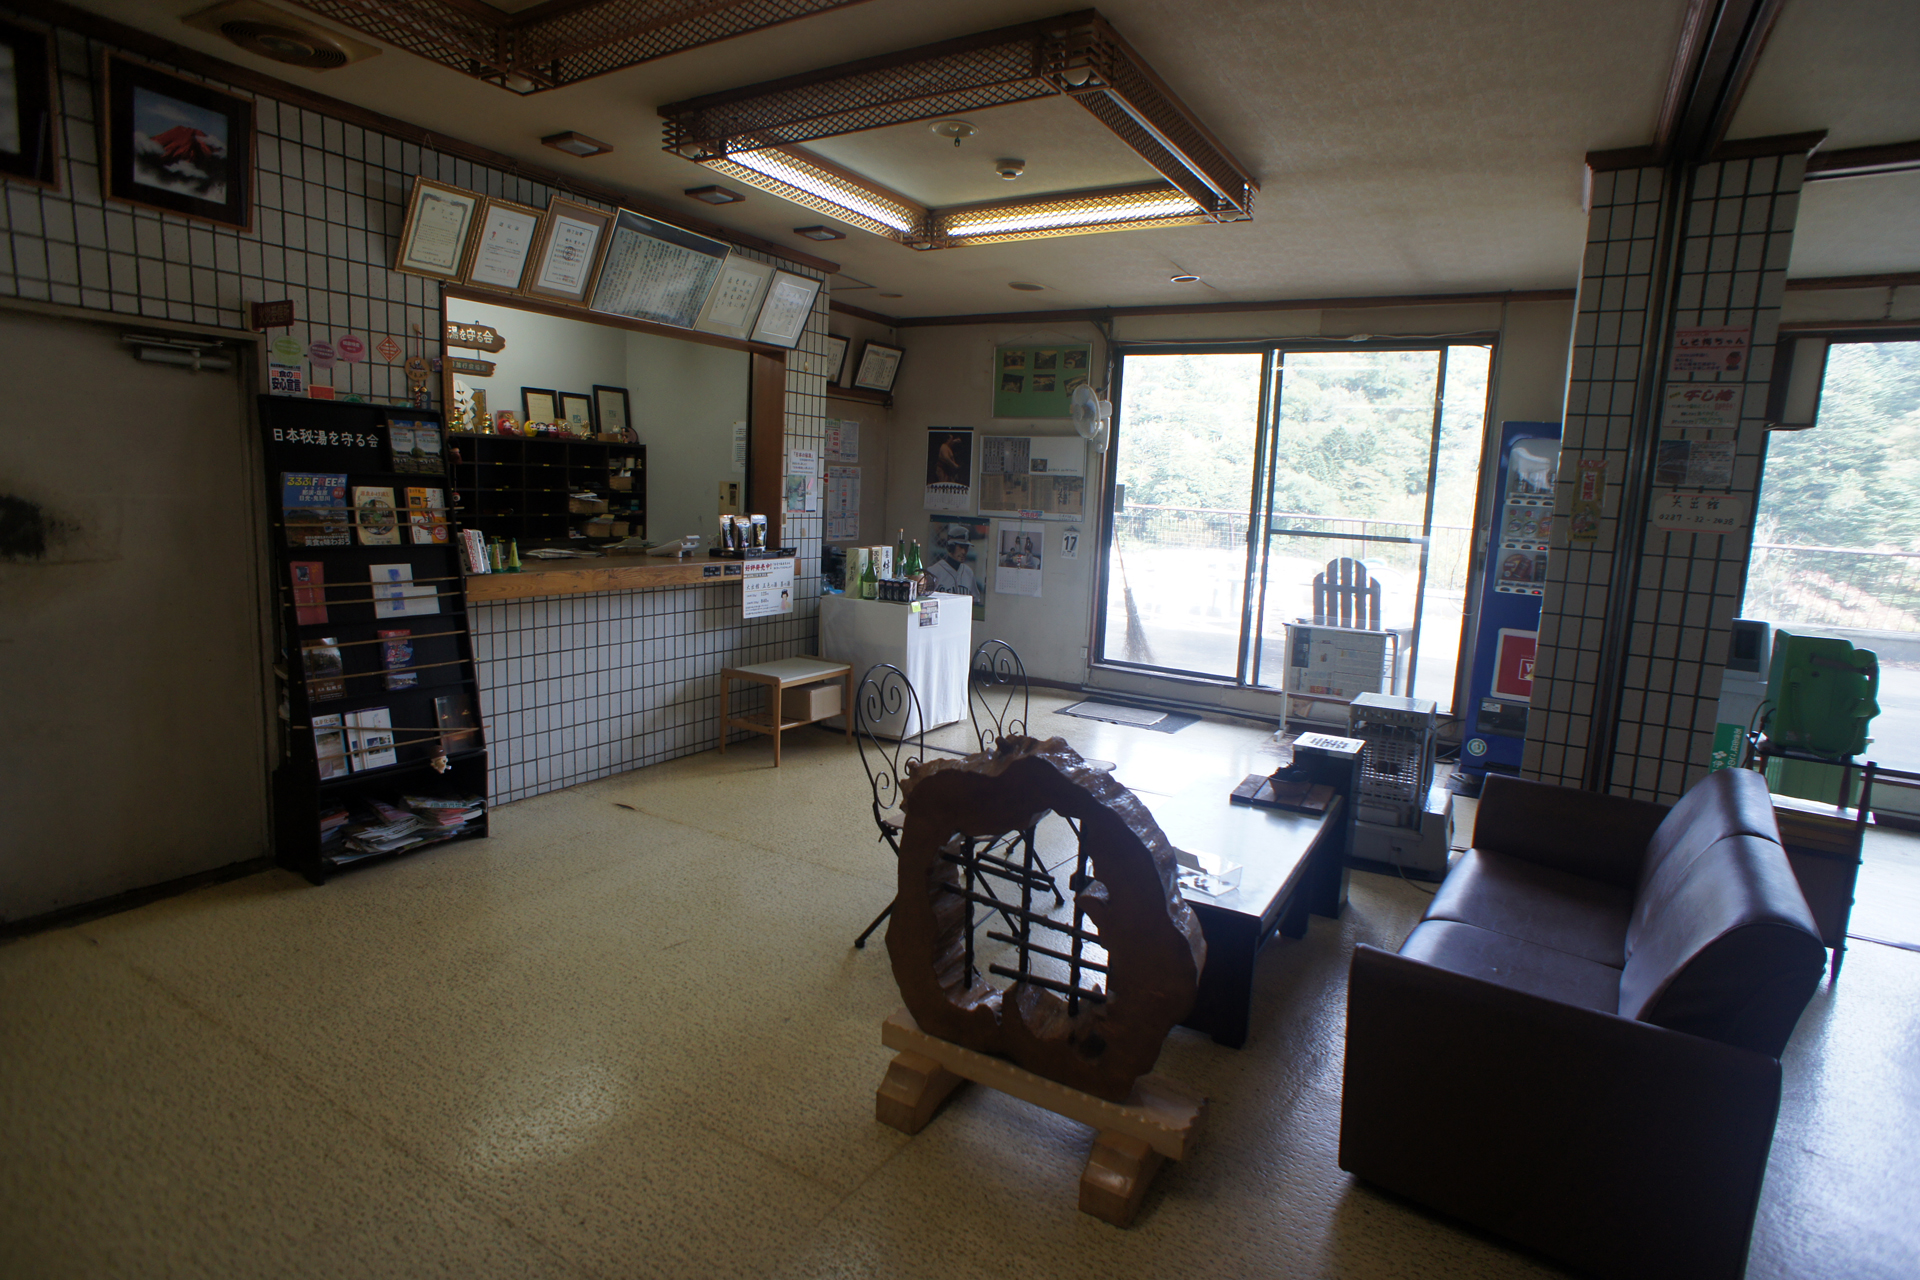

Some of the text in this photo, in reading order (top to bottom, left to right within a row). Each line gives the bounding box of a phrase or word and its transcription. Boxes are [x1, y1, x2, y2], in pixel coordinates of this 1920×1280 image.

[271, 376, 302, 393] 安心宣言
[273, 427, 380, 448] 日本秘湯を守る会
[1064, 535, 1078, 551] 17
